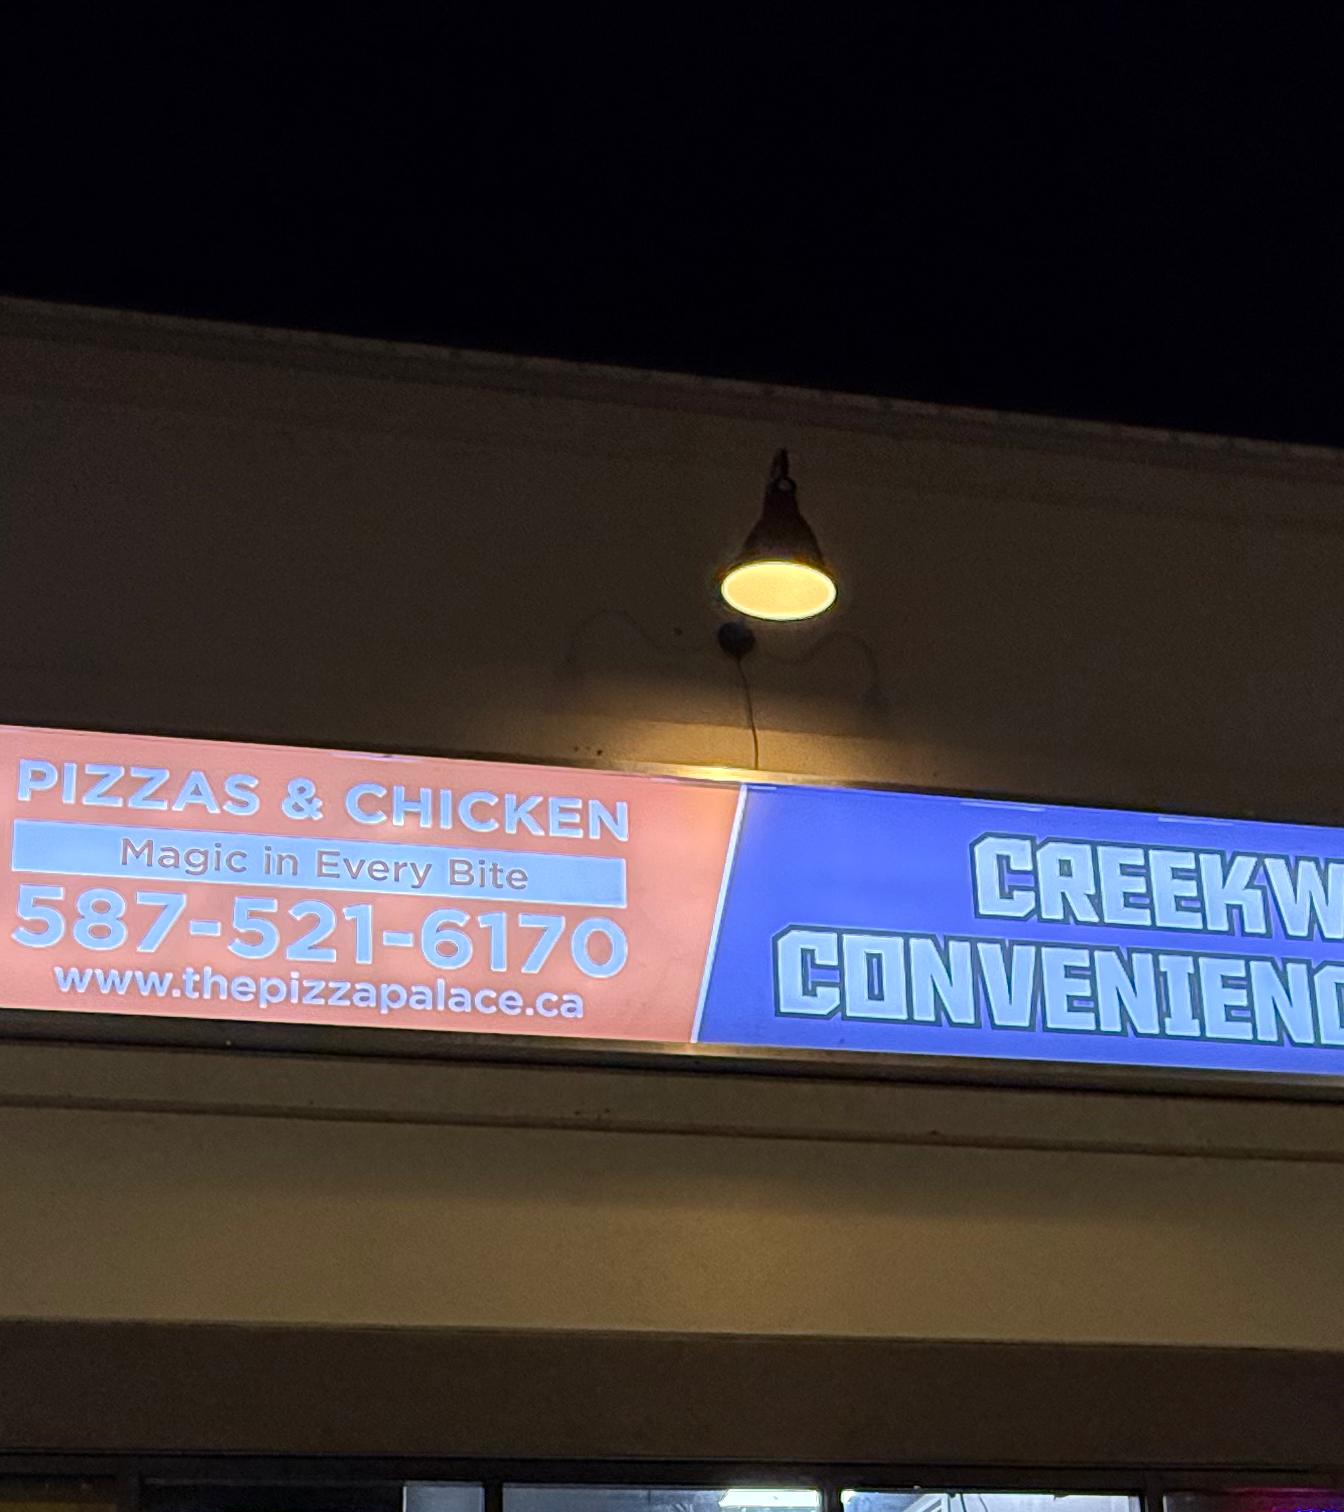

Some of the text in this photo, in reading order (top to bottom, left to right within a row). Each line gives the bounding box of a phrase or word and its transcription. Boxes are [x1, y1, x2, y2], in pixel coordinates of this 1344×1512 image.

[18, 759, 629, 842] PIZZAS & CHICKEN
[120, 837, 528, 891] Magic in Every Bite
[12, 884, 629, 979] 587-521-6170
[54, 959, 584, 1019] www.thepizzapalace.ca
